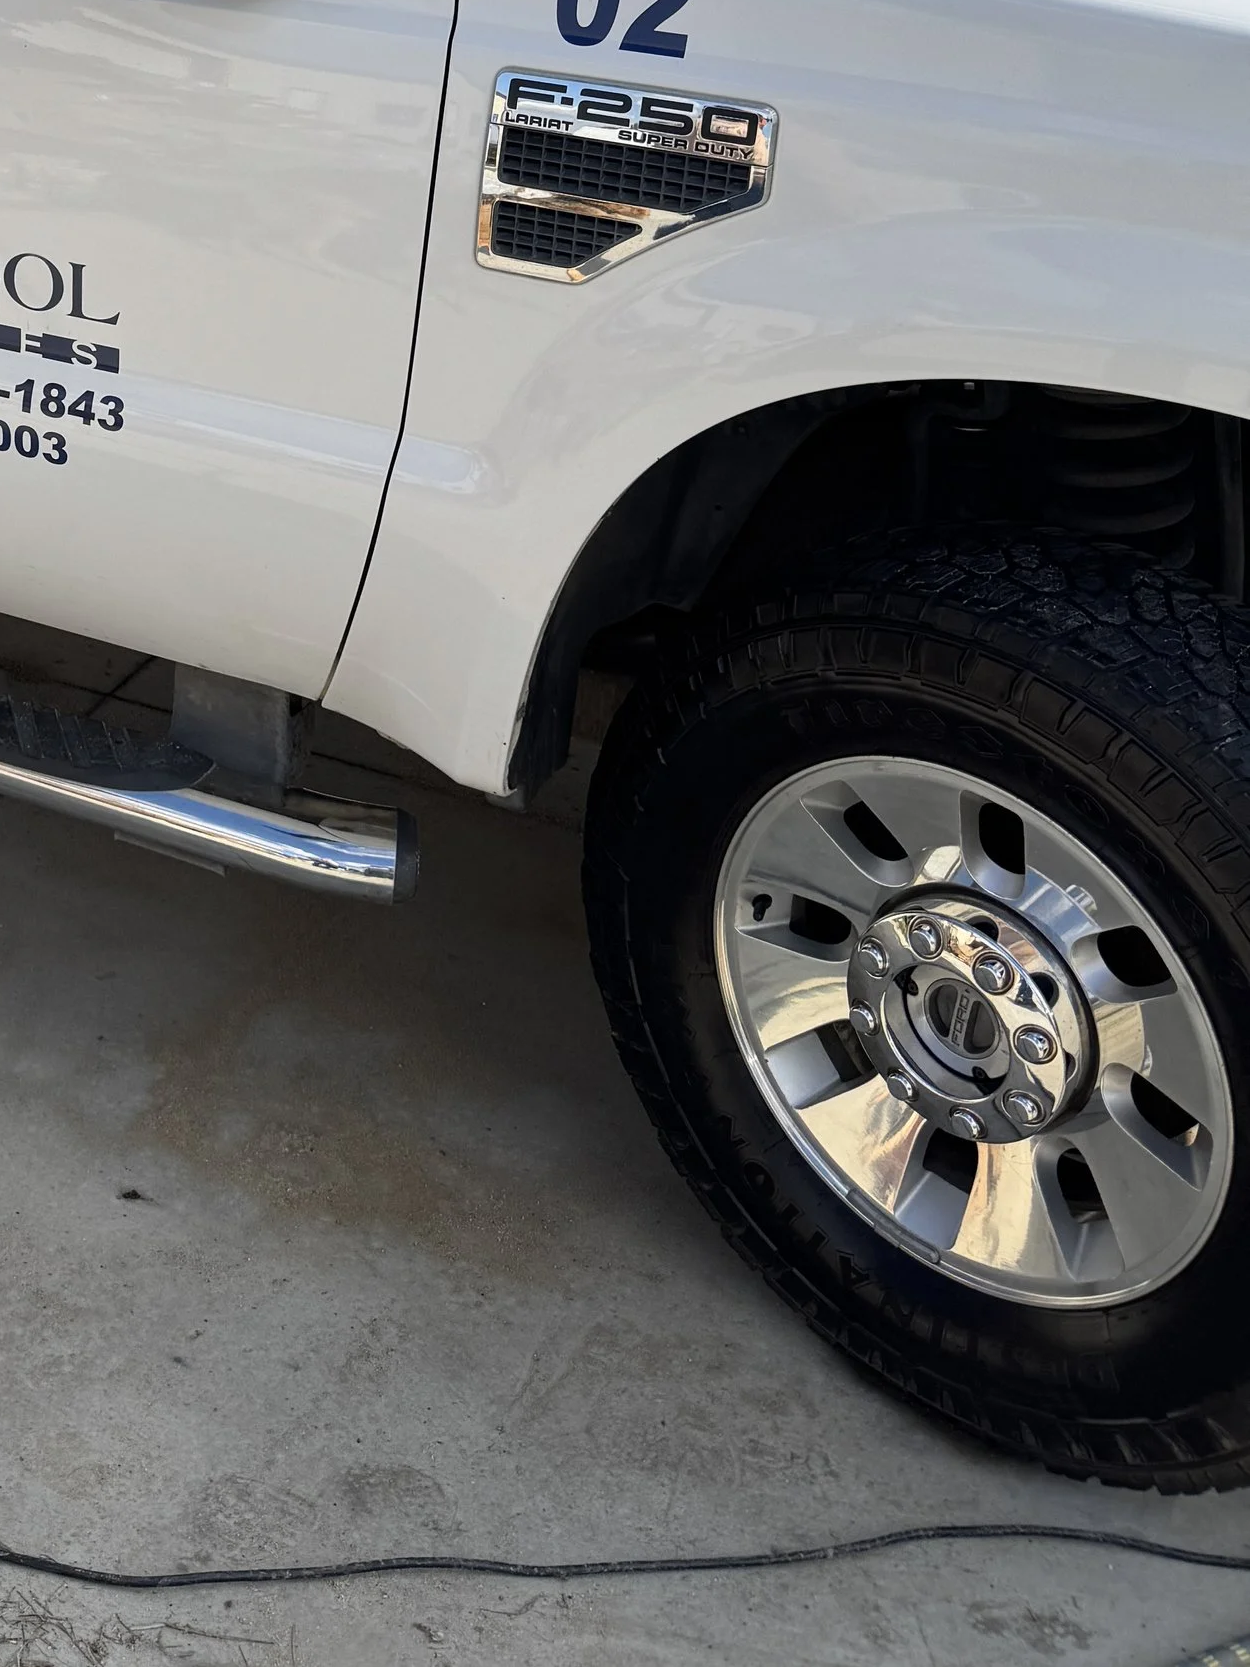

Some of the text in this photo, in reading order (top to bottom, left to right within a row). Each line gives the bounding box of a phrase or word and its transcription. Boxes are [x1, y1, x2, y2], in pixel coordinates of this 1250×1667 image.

[504, 110, 755, 160] LARIAT SUPER DUTY
[506, 77, 759, 147] F-250
[950, 993, 971, 1048] FORD
